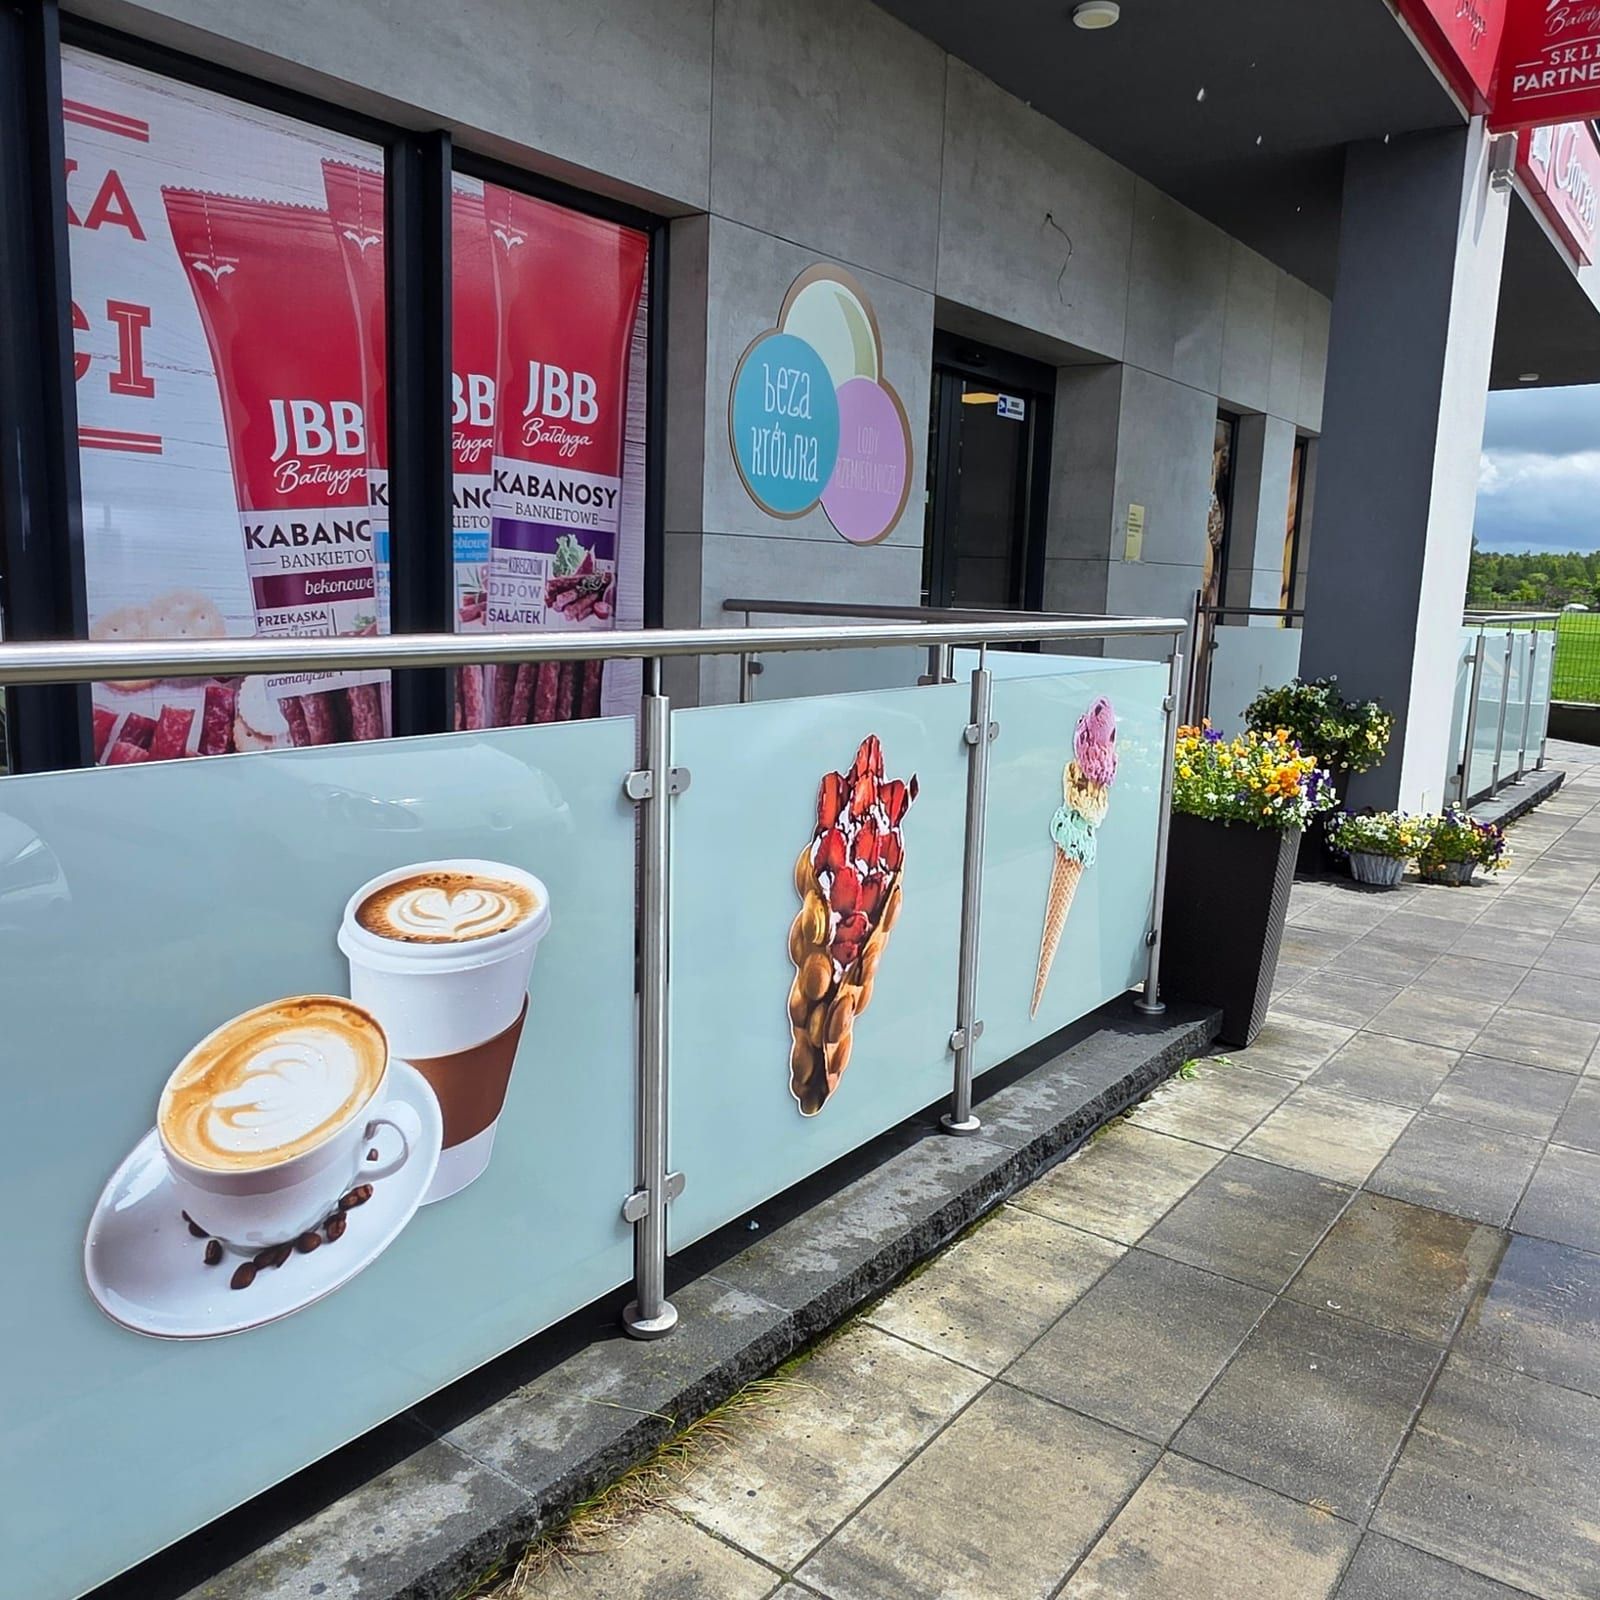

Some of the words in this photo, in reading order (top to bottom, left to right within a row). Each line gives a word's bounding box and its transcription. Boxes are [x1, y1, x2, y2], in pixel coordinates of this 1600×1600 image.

[522, 360, 599, 424] JBB
[269, 399, 366, 463] JBB
[521, 417, 593, 458] Bałdyga
[273, 459, 367, 496] Bałdyga
[493, 469, 617, 510] KABANOSY
[515, 502, 599, 526] BANKIETOWE
[305, 578, 373, 596] bekonowe
[489, 581, 542, 599] DIPÓW
[257, 610, 327, 628] PRZEKĄSKA
[488, 607, 541, 625] SAŁATEK
